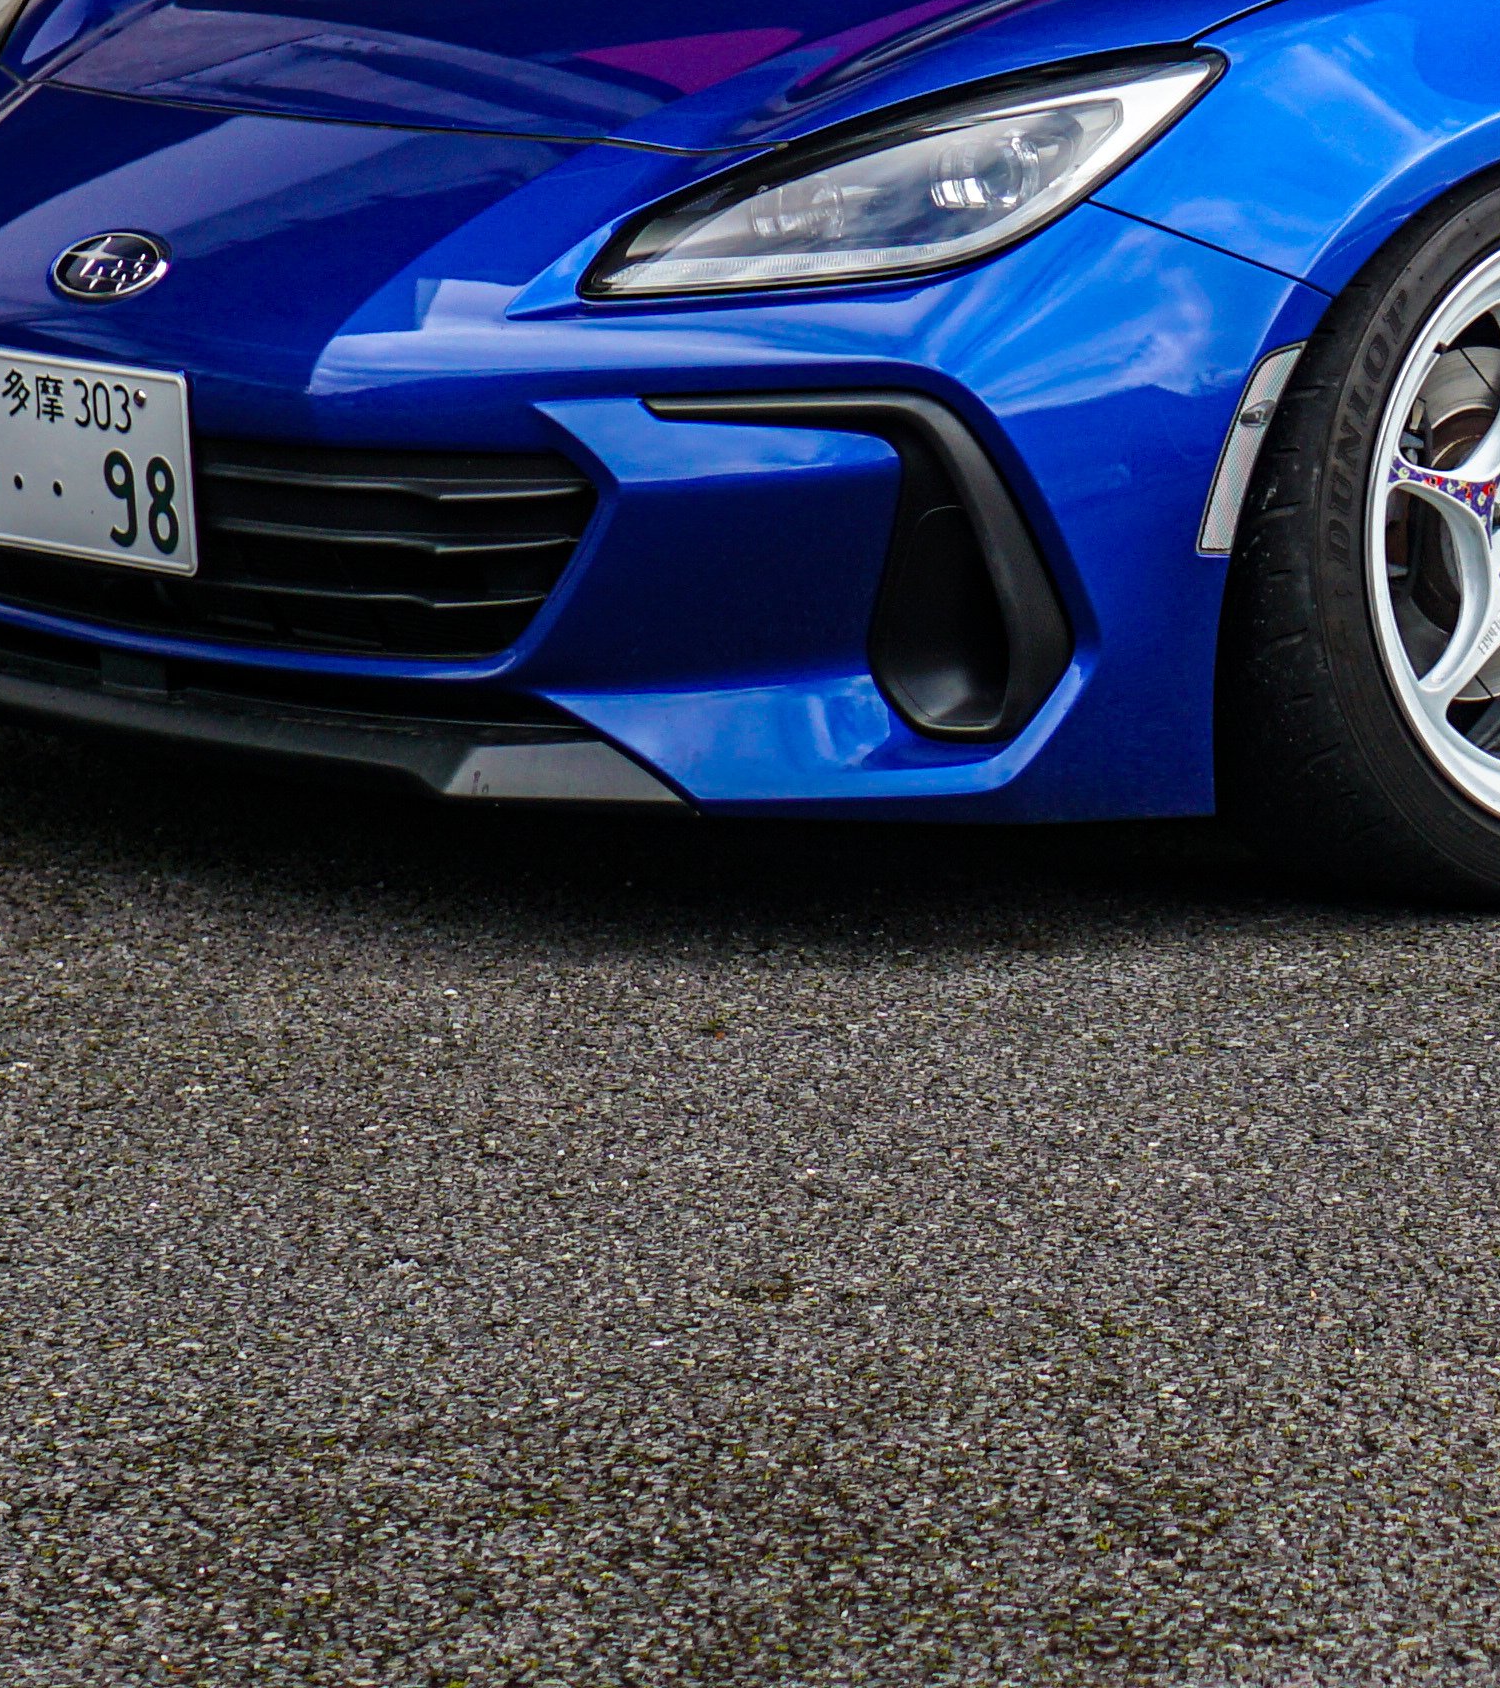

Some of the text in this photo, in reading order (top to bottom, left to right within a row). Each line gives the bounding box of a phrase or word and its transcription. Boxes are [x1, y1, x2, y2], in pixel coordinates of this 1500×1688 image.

[1, 368, 133, 435] 多摩 303
[1324, 285, 1412, 575] DUNLOP
